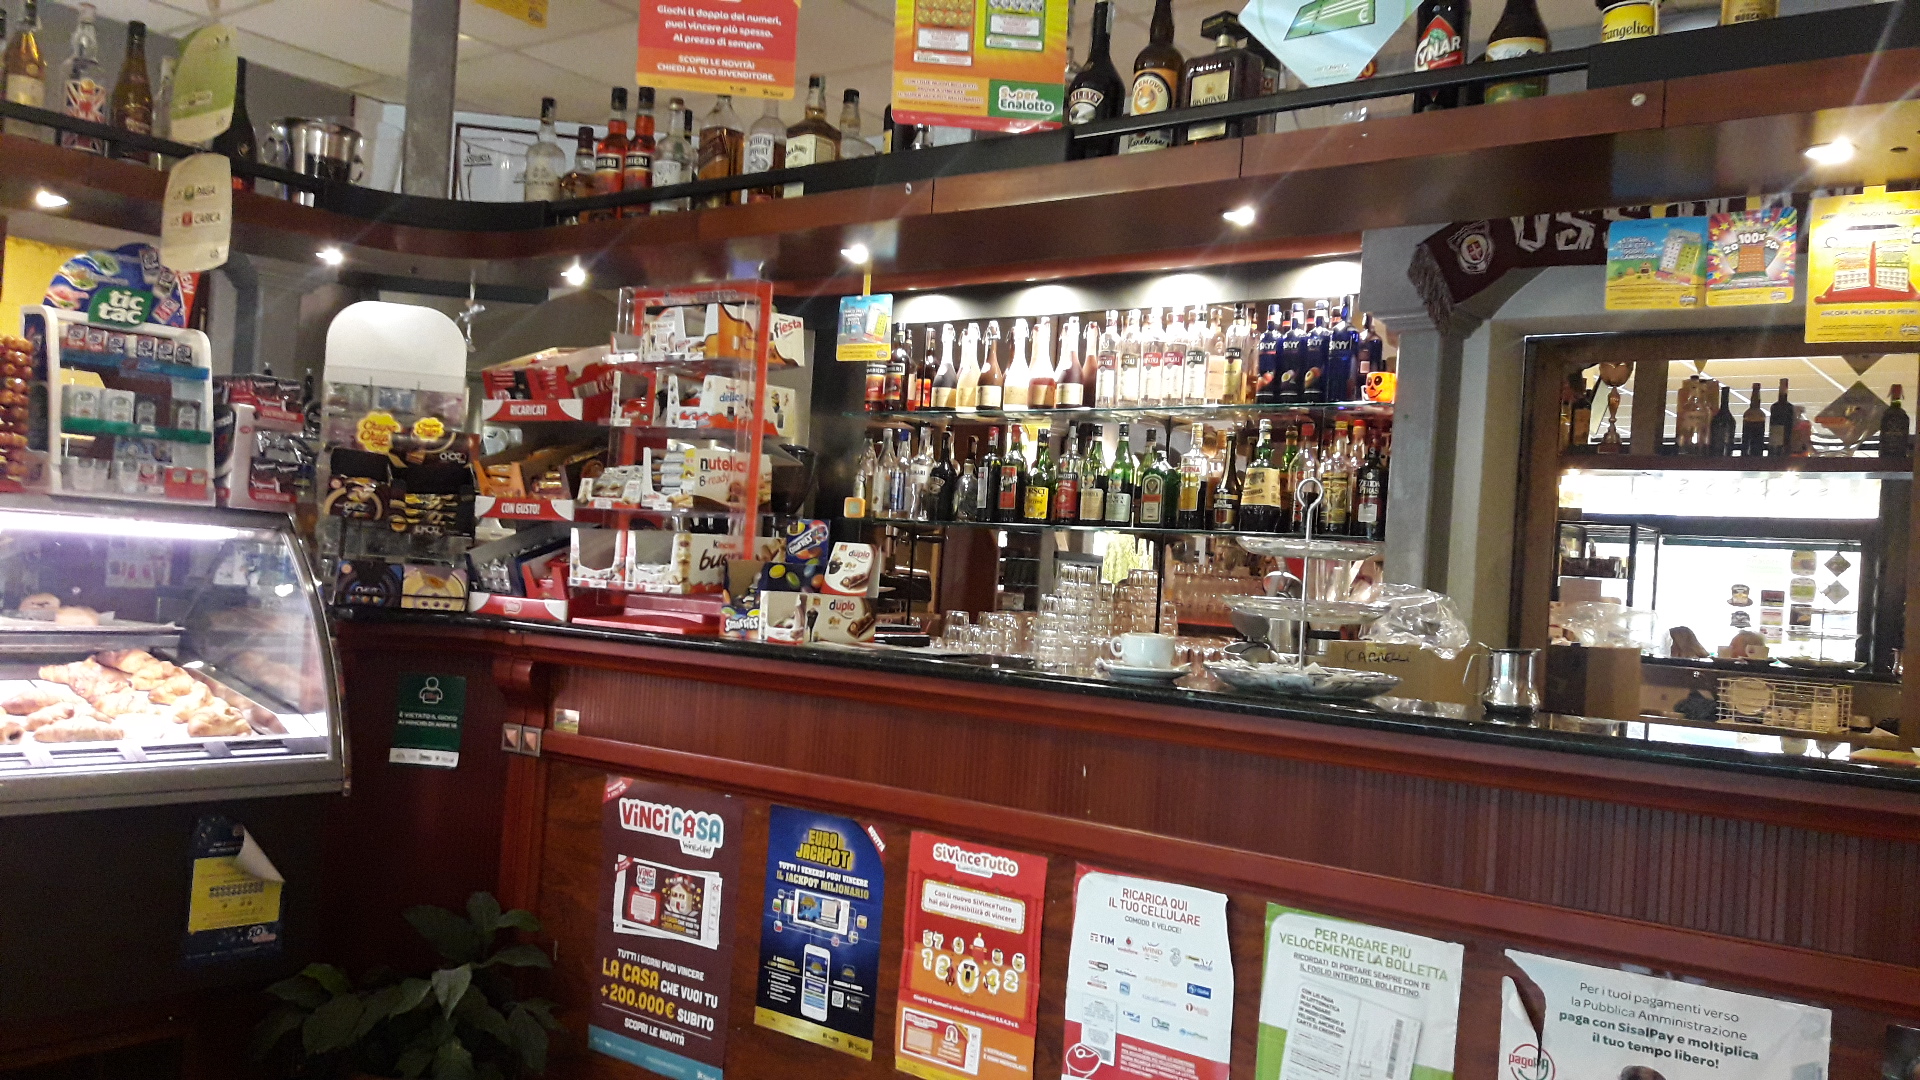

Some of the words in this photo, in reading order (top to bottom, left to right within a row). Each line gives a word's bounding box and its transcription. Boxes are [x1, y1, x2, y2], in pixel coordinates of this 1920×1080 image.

[696, 9, 728, 20] doppio
[665, 20, 686, 29] puoi
[688, 22, 721, 32] vincere
[740, 27, 773, 38] spesso.
[673, 33, 683, 42] Al
[684, 34, 715, 45] prezzo
[717, 38, 726, 46] di
[728, 40, 764, 50] sempre.
[678, 55, 708, 65] SCOPRI
[710, 58, 720, 66] LE
[1414, 36, 1461, 71] CYNAR
[657, 63, 685, 73] CHIEDI
[686, 66, 697, 74] AL
[699, 68, 716, 76] TUO
[1001, 87, 1037, 100] Super
[1001, 99, 1053, 113] Enalotto
[1738, 232, 1766, 244] 100x
[110, 290, 144, 310] tic
[98, 302, 142, 325] tac
[774, 320, 802, 339] fiesta
[1260, 342, 1277, 350] SKYY
[1283, 341, 1300, 349] SKYY
[1307, 338, 1322, 346] SKYY
[1328, 340, 1350, 350] SKYY
[510, 404, 547, 416] RICARICATI
[1359, 480, 1381, 489] ZEDDA
[1359, 486, 1380, 494] PIRAS
[501, 502, 514, 514] CON
[516, 502, 540, 514] GUSTO!
[848, 548, 870, 560] duplo
[828, 599, 856, 612] duplo
[808, 829, 839, 849] EURO
[796, 842, 850, 869] JACKPOT
[934, 846, 1016, 874] SiVinceTutto
[779, 861, 796, 872] TUTTI
[826, 872, 842, 882] PUOI
[842, 875, 868, 888] VINCERE
[776, 870, 784, 880] IL
[785, 872, 820, 889] JACKPOT
[820, 880, 870, 900] MILIONARIO
[934, 890, 946, 898] Con
[946, 892, 952, 900] il
[952, 894, 972, 904] nuovo
[973, 898, 1012, 914] SiVinceTutto
[1122, 888, 1168, 908] RICARICA
[1170, 899, 1188, 912] QUI
[939, 900, 949, 909] più
[950, 902, 984, 916] possibilità
[992, 912, 1017, 924] vincere!
[1108, 896, 1118, 908] IL
[1120, 899, 1140, 913] TUO
[1142, 904, 1200, 926] CELLULARE
[1125, 916, 1150, 926] COMODO
[1157, 922, 1182, 934] VELOCE!
[1100, 934, 1114, 946] TIM
[1315, 928, 1338, 943] PER
[1341, 932, 1388, 954] PAGARE
[1392, 944, 1412, 960] PIÙ
[618, 948, 637, 960] TUTTI
[638, 954, 640, 962] I
[641, 955, 660, 968] GIORNI
[662, 961, 676, 972] PUOI
[678, 965, 704, 982] VINCERE
[1280, 932, 1364, 963] VELOCEMENTE
[1368, 954, 1382, 966] LA
[1386, 957, 1448, 982] BOLLETTA
[1294, 952, 1329, 967] RICORDATI
[1332, 960, 1338, 968] DI
[1340, 962, 1372, 977] PORTARE
[1373, 970, 1403, 984] SEMPRE
[1404, 977, 1420, 988] CON
[1421, 982, 1430, 990] TE
[1300, 964, 1307, 972] IL
[1307, 965, 1332, 978] FOGLIO
[1333, 970, 1360, 984] INTERO
[1360, 977, 1374, 988] DEL
[1374, 980, 1420, 998] BOLLETTINO
[602, 958, 620, 979] LA
[622, 963, 658, 990] CASA
[660, 980, 679, 996] CHE
[681, 986, 703, 1004] VUOI
[704, 992, 718, 1008] TU
[1580, 982, 1600, 996] Per
[1602, 986, 1606, 996] i
[1608, 988, 1632, 1002] tuoi
[1634, 994, 1701, 1014] pagamenti
[1703, 1007, 1740, 1023] verso
[624, 1018, 648, 1034] SCOPRI
[648, 1026, 658, 1038] LE
[677, 1008, 714, 1032] SUBITO
[1572, 996, 1581, 1007] la
[1584, 999, 1635, 1018] Pubblica
[1638, 1012, 1748, 1042] Amministrazione
[1559, 1011, 1590, 1026] paga
[1592, 1018, 1616, 1031] con
[1618, 1022, 1674, 1044] SisalPay
[1677, 1035, 1685, 1044] e
[1688, 1038, 1759, 1061] moltiplica
[1592, 1032, 1600, 1043] il
[1603, 1036, 1625, 1048] tuo
[1628, 1040, 1672, 1058] tempo
[1675, 1050, 1720, 1069] libero!
